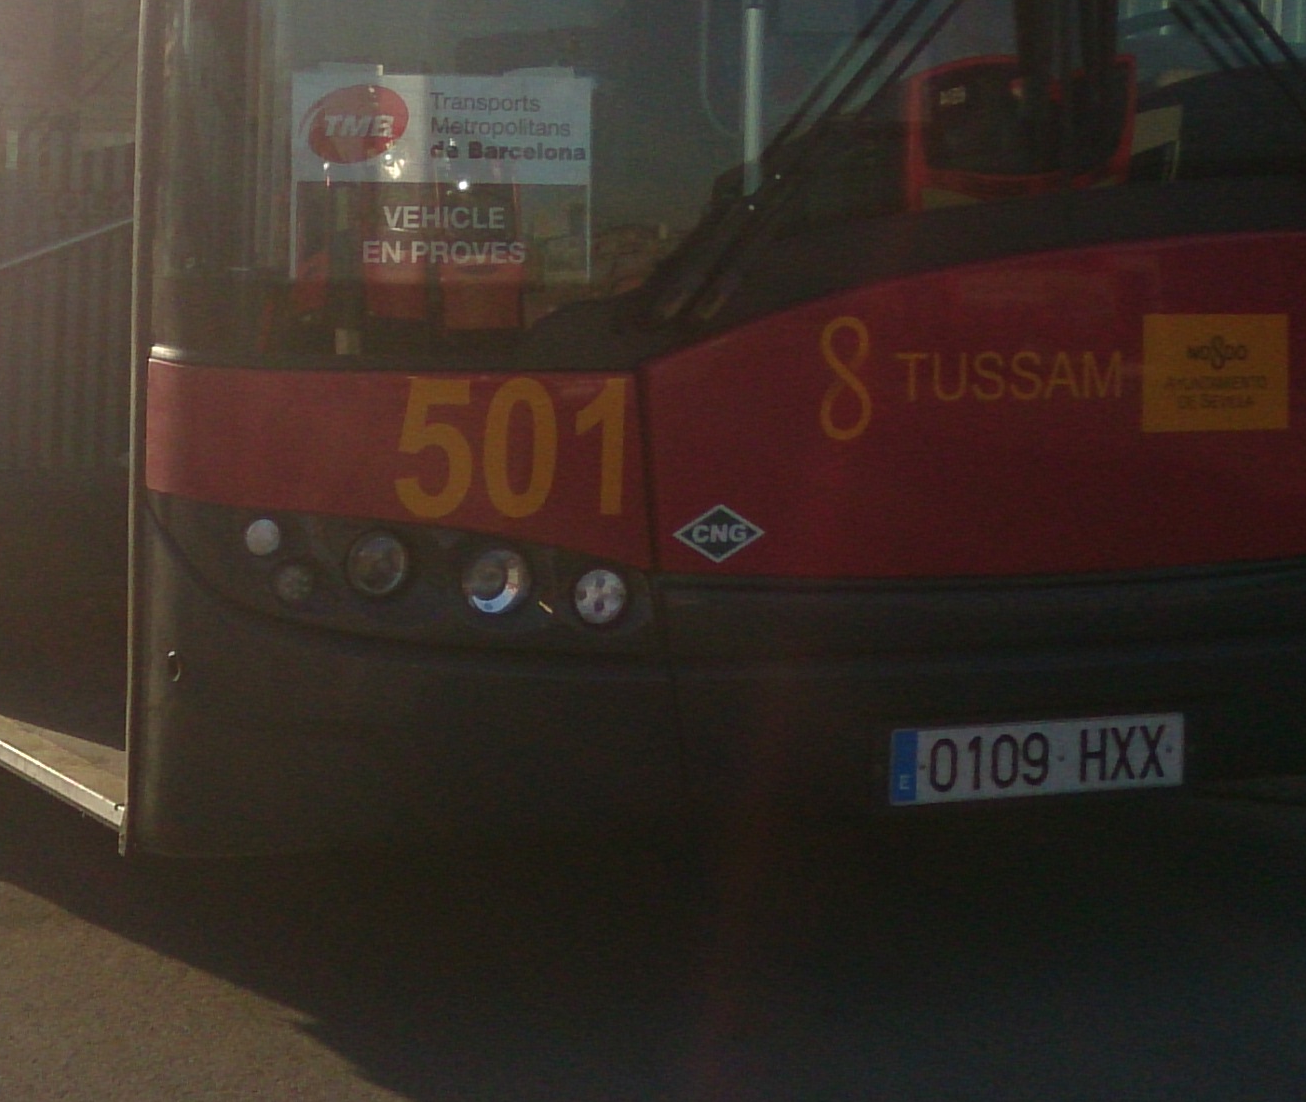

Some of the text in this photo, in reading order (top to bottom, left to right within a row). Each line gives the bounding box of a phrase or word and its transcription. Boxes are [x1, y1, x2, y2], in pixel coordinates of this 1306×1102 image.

[430, 91, 541, 113] Transports
[323, 114, 394, 138] TMB
[430, 116, 571, 139] Metropolitans
[430, 141, 587, 161] de Barcelona
[383, 205, 505, 229] VEHICLE
[362, 240, 526, 264] EN PROVES
[896, 351, 1123, 399] TUSSAM
[395, 377, 627, 518] 501
[692, 523, 748, 545] CNG
[929, 732, 1050, 792] 0109
[1079, 724, 1165, 782] HXX
